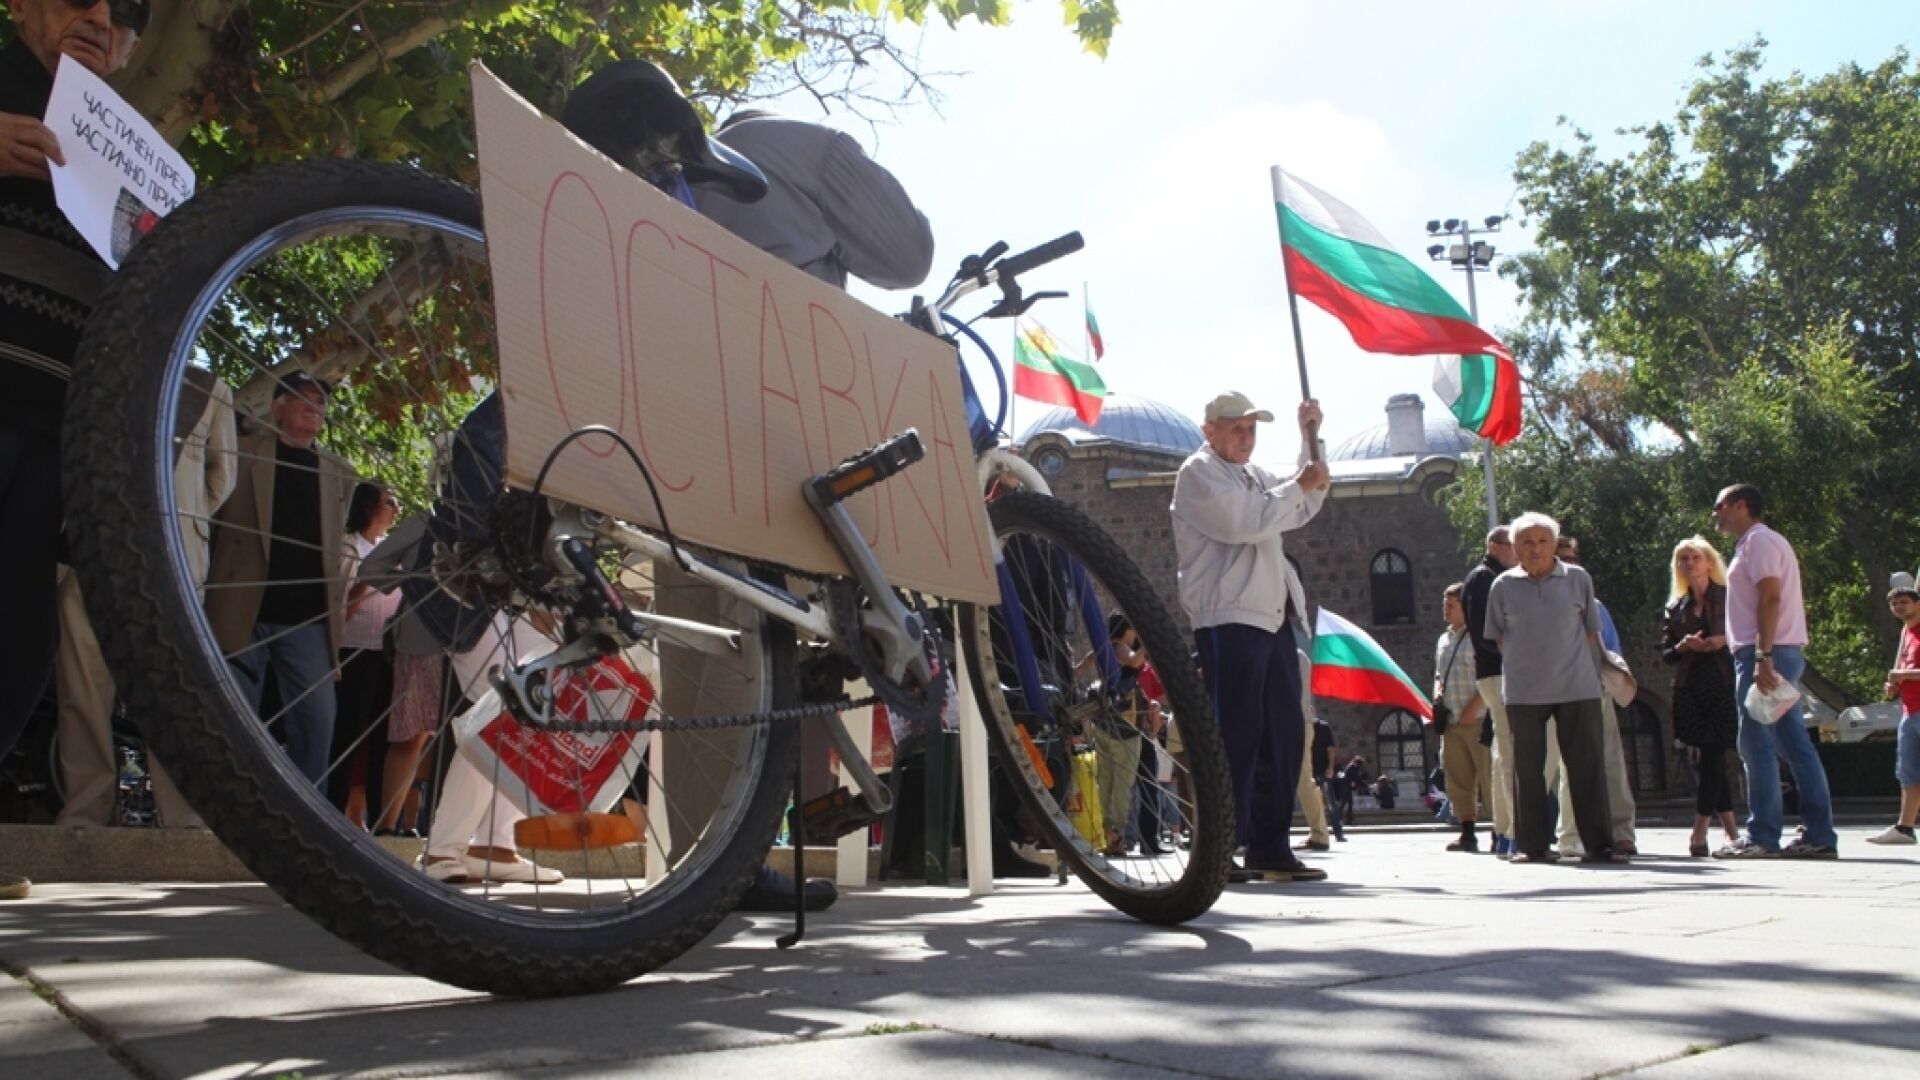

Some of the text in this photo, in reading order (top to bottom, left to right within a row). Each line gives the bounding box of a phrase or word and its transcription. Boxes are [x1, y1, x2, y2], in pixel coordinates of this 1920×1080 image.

[70, 112, 179, 209] ЧАСТИЧНО ПРИ
[83, 90, 192, 198] ЧАСТИЧЕН ПРЕЗ
[540, 170, 988, 581] ОСТАВКА
